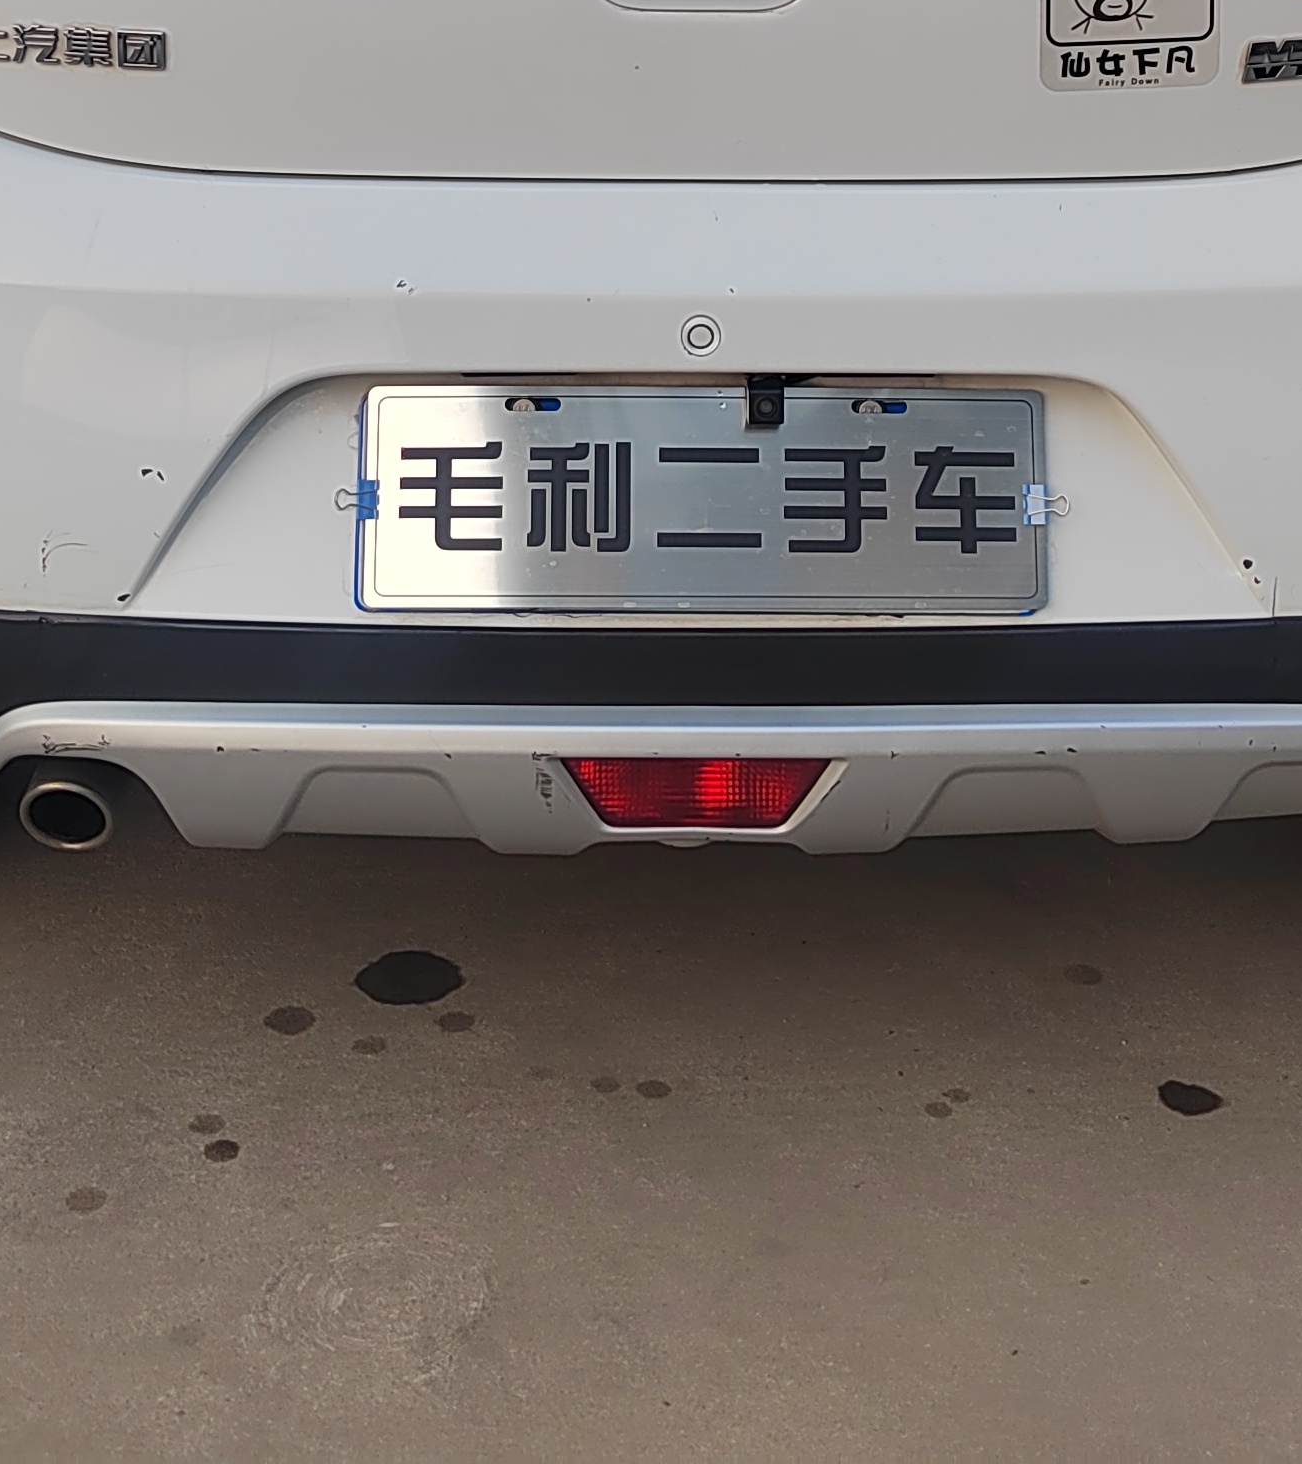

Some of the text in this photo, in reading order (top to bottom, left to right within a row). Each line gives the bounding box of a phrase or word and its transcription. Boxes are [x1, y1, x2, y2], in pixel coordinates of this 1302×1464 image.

[1060, 45, 1196, 78] 仙女下凡
[1098, 77, 1160, 88] Fairy Down
[399, 441, 1017, 554] 毛利二手车
